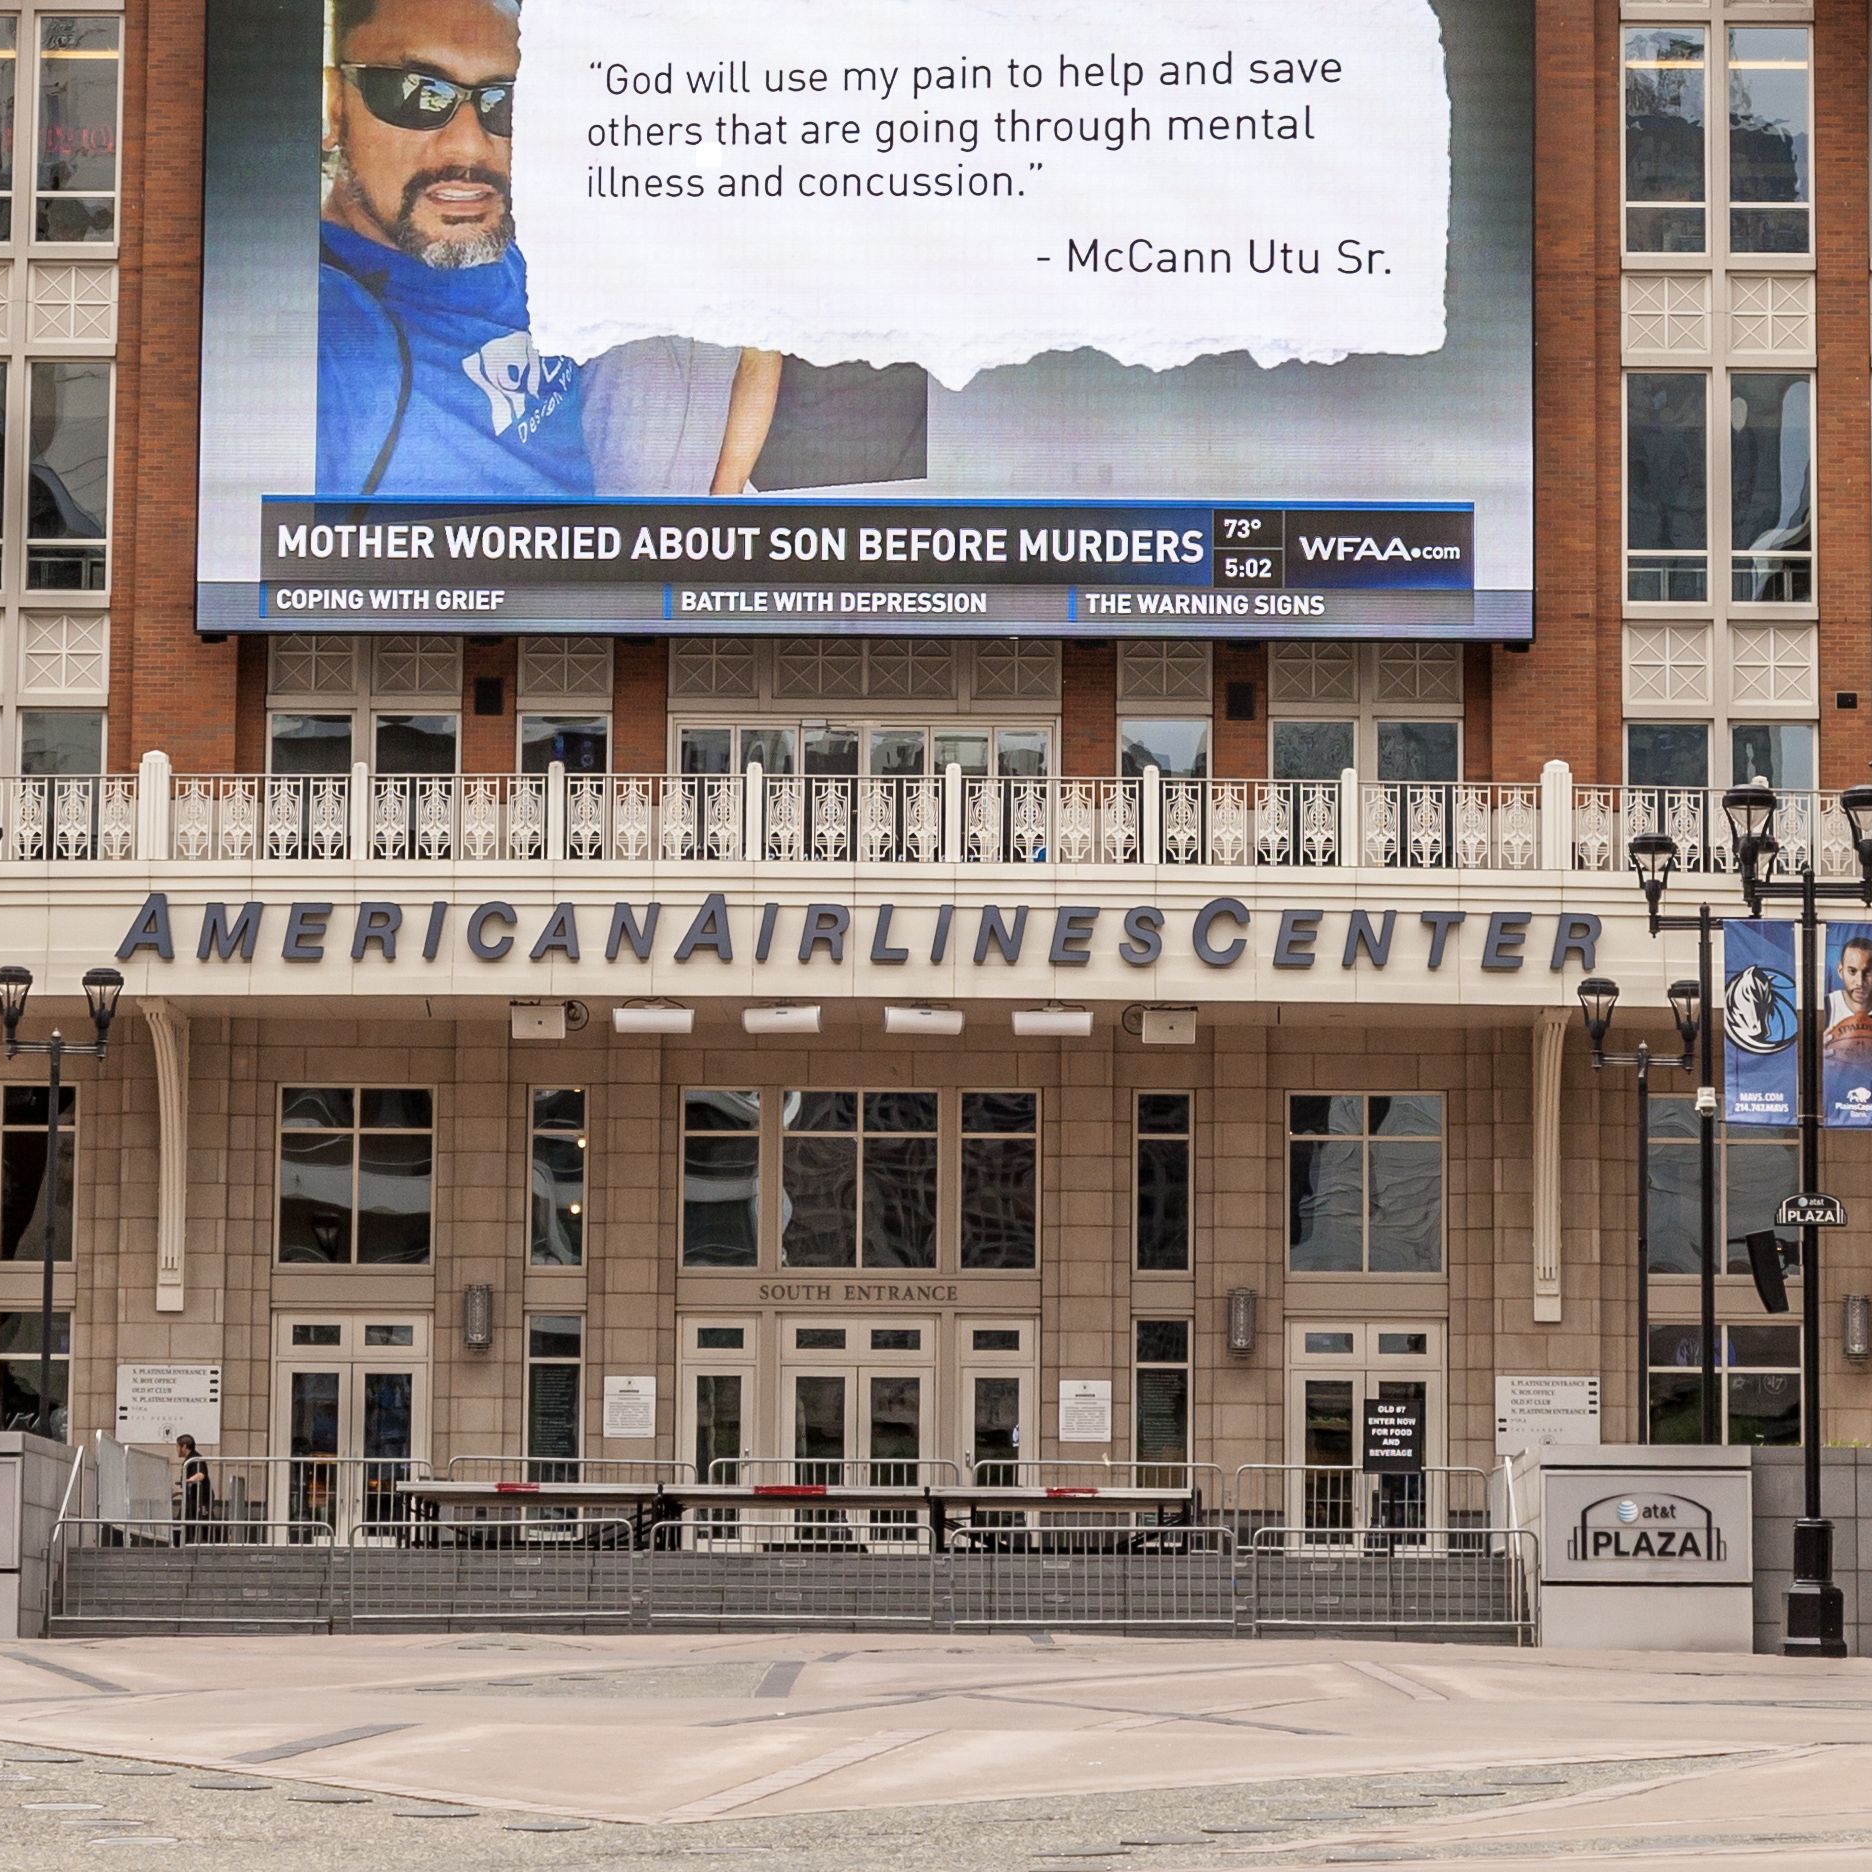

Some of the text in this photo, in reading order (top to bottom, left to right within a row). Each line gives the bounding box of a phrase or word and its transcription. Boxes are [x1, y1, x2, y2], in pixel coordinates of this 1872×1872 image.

[687, 61, 750, 94] will
[766, 69, 828, 92] use
[844, 67, 898, 100] my
[913, 56, 992, 99] pain
[1008, 58, 1042, 87] to
[1060, 53, 1144, 96] help
[1159, 51, 1232, 85] and
[1249, 58, 1342, 84] save
[588, 105, 1316, 153] others that are going through mental
[588, 166, 705, 197] illness
[717, 165, 782, 197] and
[1068, 239, 1232, 273] McCann
[1249, 239, 1320, 274] Utu
[1337, 240, 1391, 274] Sr.
[277, 525, 1205, 564] MOTHER WORRIED ABOUT SON BEFORE MURDERS
[1224, 559, 1272, 578] 5:02
[277, 589, 505, 610] COPING WITH GRIEF
[681, 591, 988, 613] BATTLE WITH DEPRESSION
[1086, 593, 1325, 616] THE WARNING SIGNS
[1739, 1092, 1784, 1102] MAVS.COM
[1788, 1210, 1835, 1222] PLAZA
[759, 1284, 959, 1301] SOUTH ENTRANCE
[1377, 1405, 1394, 1414] OLD
[1368, 1417, 1395, 1425] ENTER
[1371, 1428, 1388, 1436] FOR
[1382, 1438, 1401, 1446] AND
[1369, 1449, 1413, 1457] BEVERAGE
[1642, 1504, 1677, 1519] at&t
[1592, 1530, 1702, 1557] PLAZA
